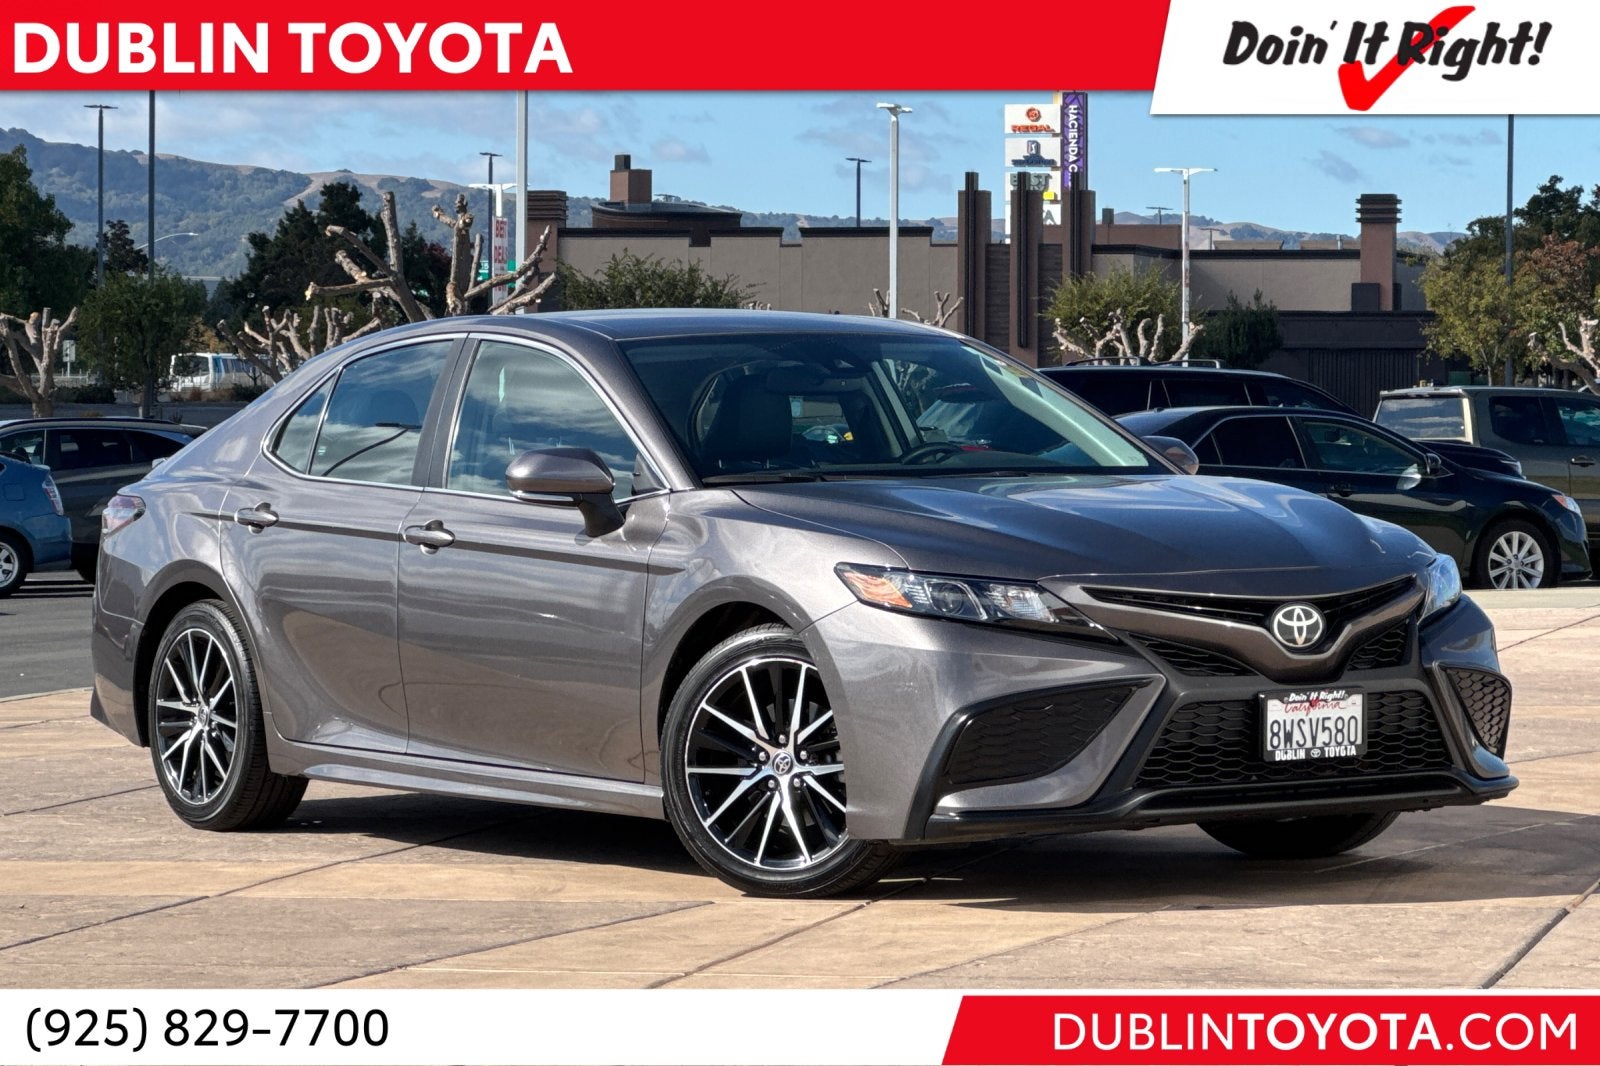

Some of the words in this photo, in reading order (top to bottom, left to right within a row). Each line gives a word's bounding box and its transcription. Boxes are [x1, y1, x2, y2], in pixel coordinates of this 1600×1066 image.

[1068, 105, 1078, 162] HACIENDA
[1270, 715, 1358, 749] 8WSV580
[1275, 748, 1306, 761] DUBLIN
[1324, 745, 1357, 758] TOYOTA
